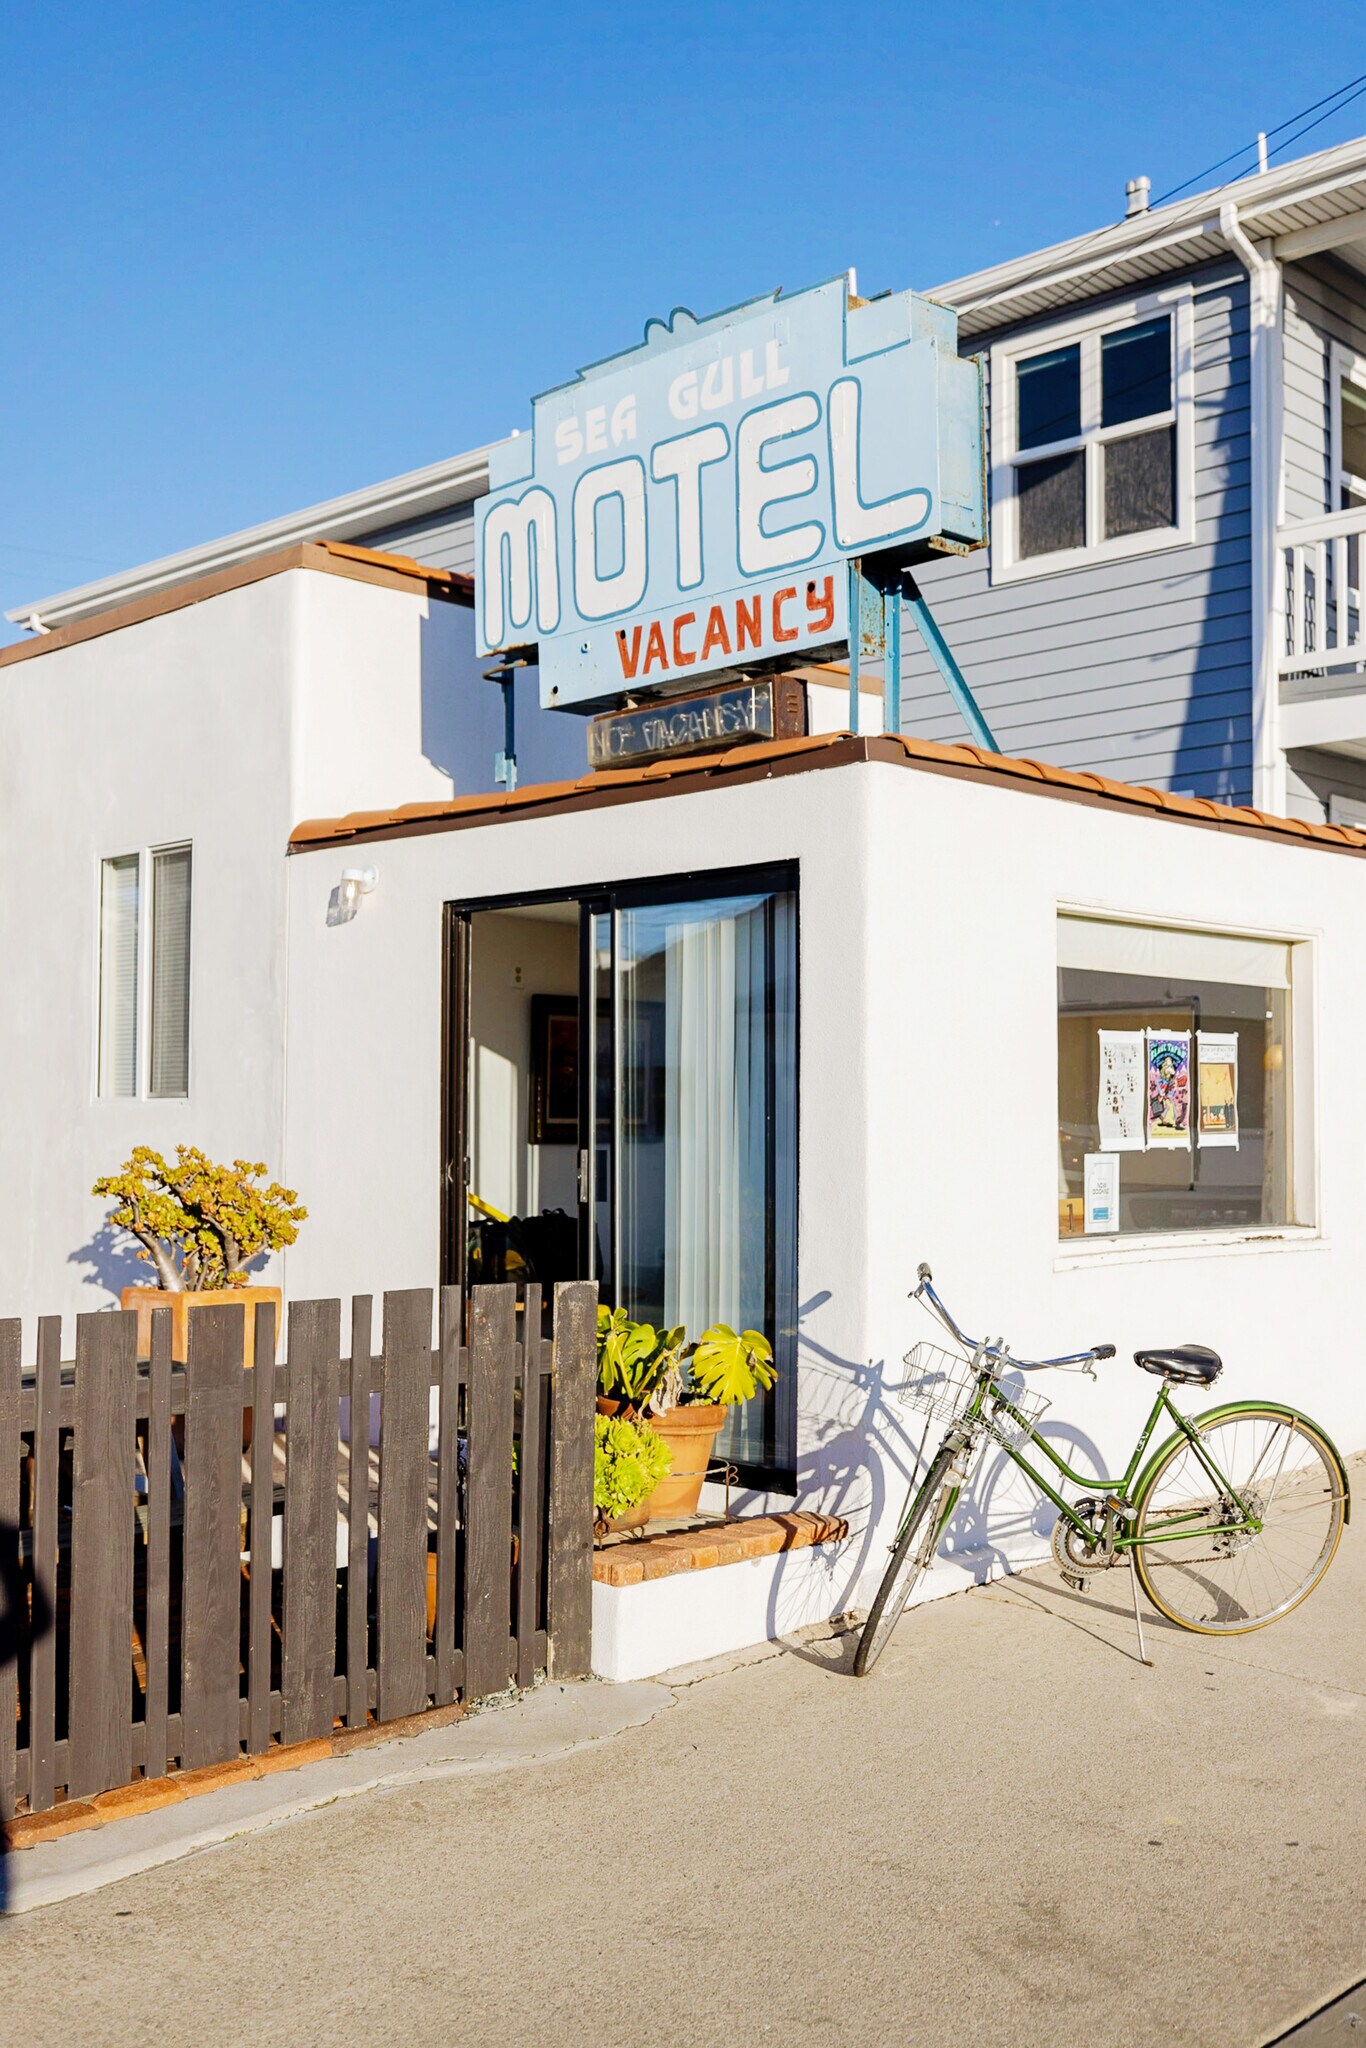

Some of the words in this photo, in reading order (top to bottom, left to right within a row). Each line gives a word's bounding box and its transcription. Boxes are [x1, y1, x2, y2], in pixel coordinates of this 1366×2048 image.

[554, 395, 638, 466] SEA
[668, 339, 792, 421] GULL
[482, 375, 933, 650] MOTEL
[615, 575, 836, 680] VACANCY
